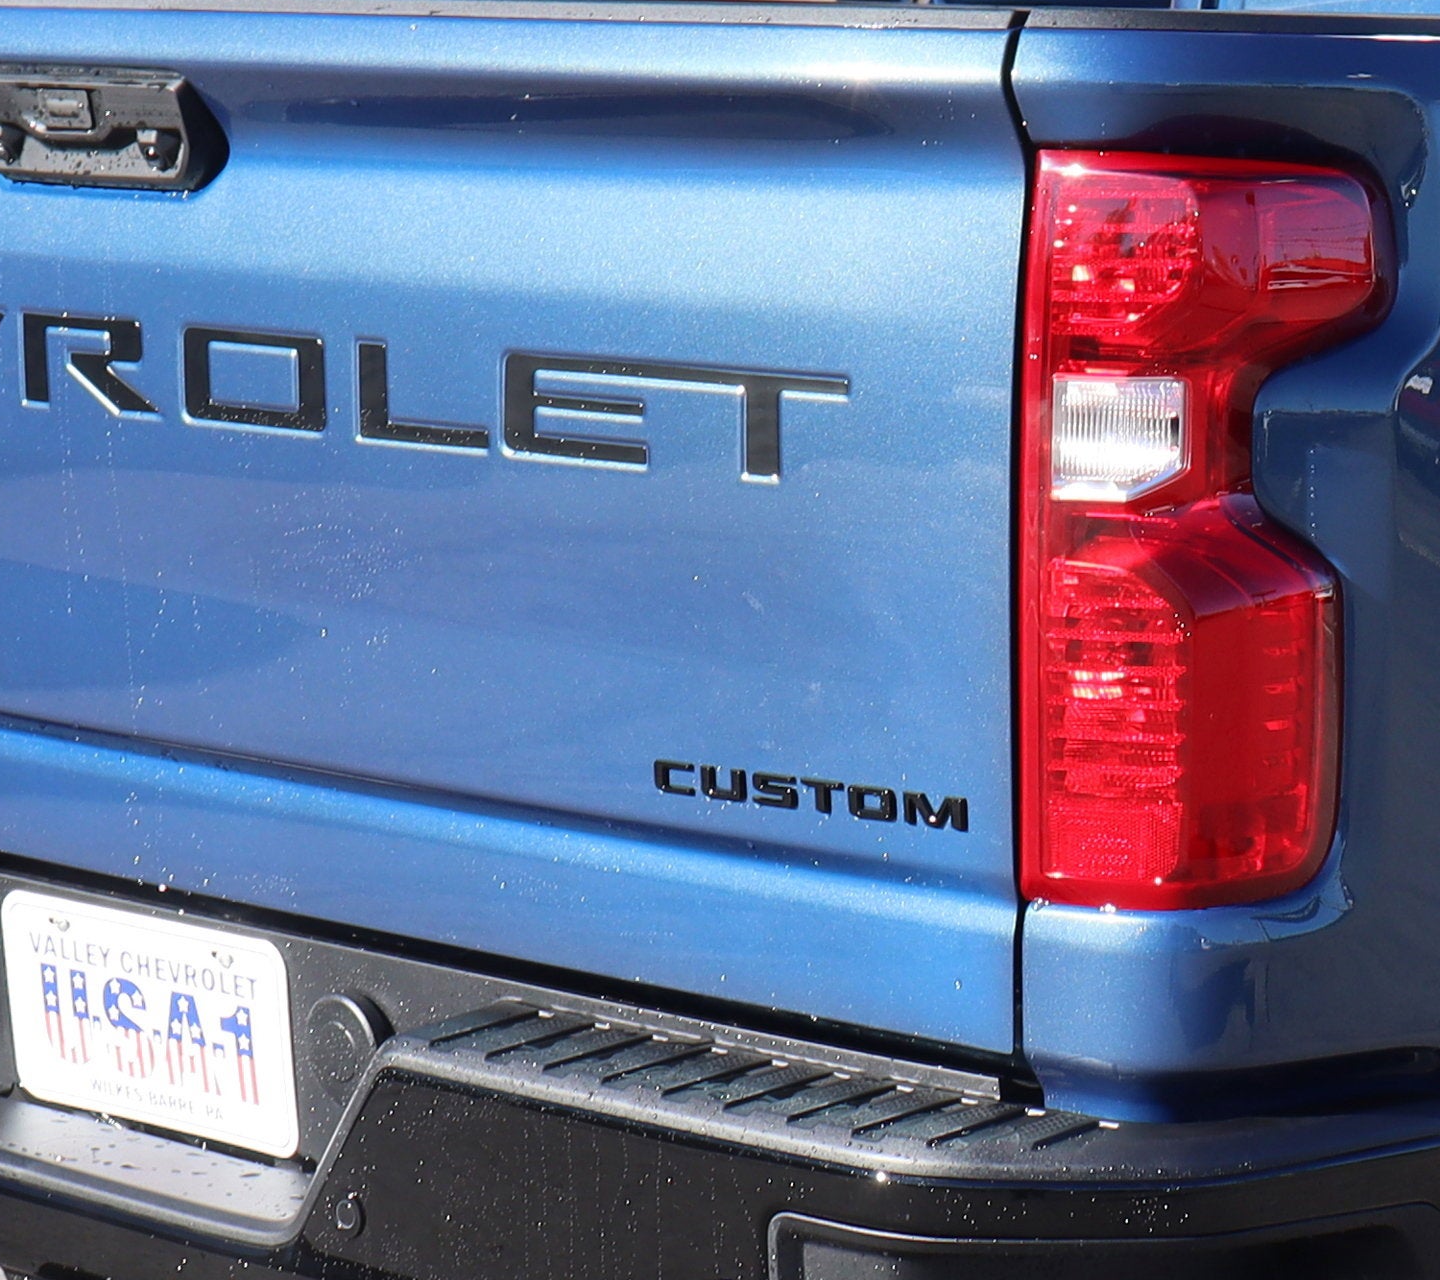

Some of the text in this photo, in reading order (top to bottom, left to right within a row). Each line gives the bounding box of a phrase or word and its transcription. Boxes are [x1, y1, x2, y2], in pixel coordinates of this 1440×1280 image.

[654, 758, 970, 833] CUSTOM
[29, 931, 258, 1001] VALLEY CHEVROLET
